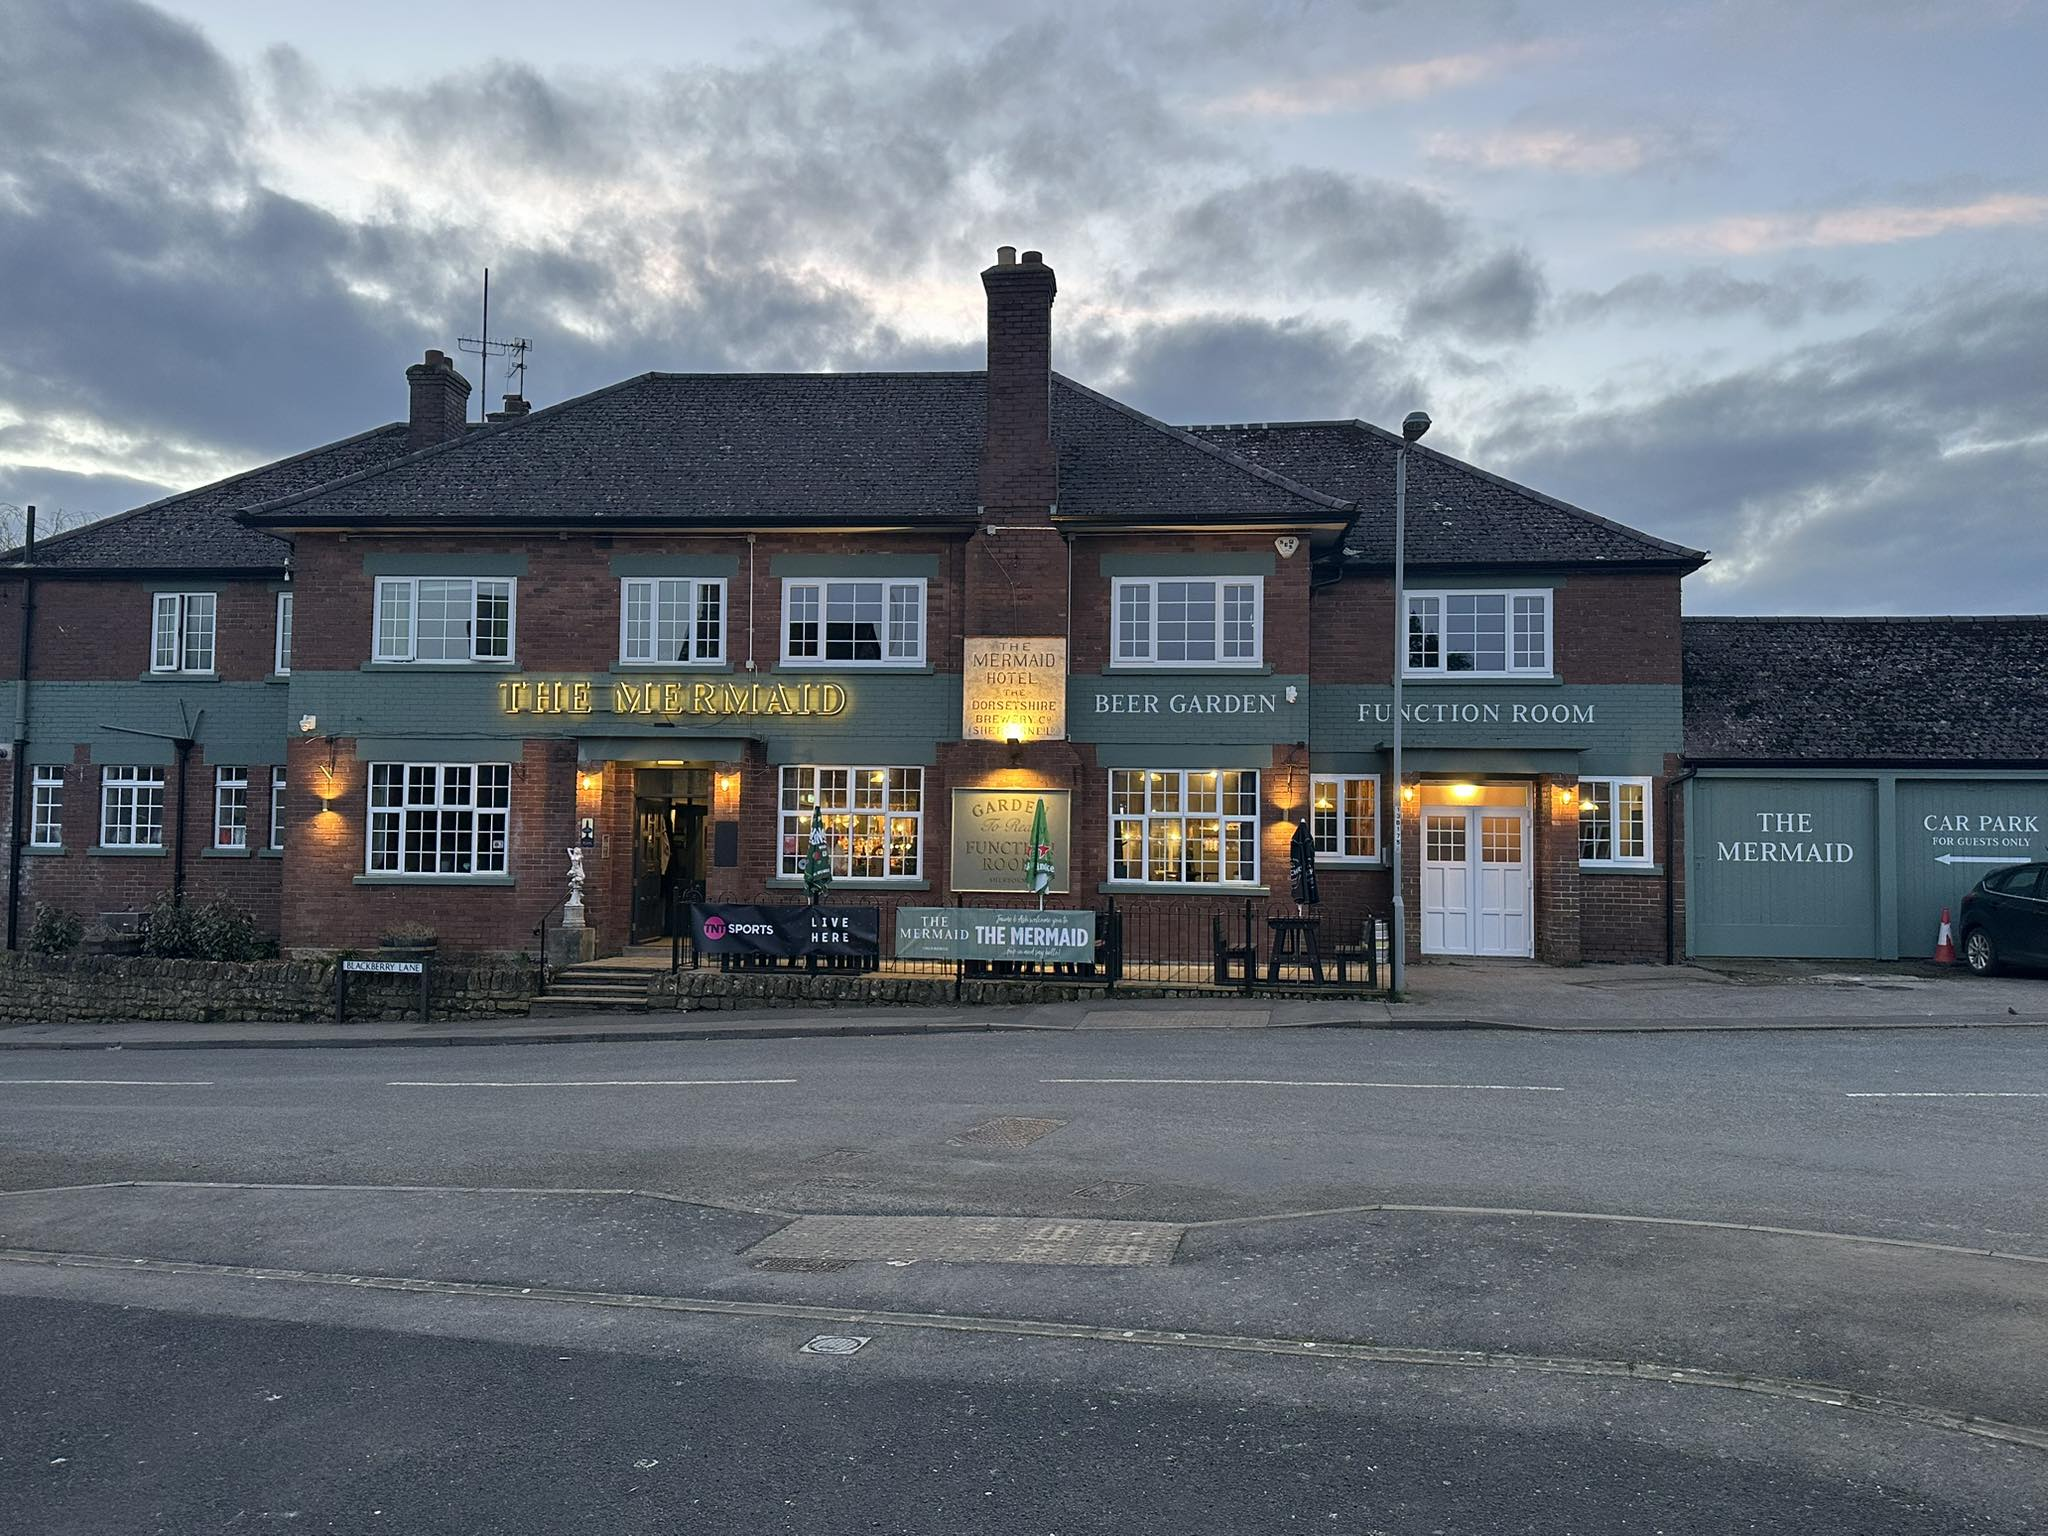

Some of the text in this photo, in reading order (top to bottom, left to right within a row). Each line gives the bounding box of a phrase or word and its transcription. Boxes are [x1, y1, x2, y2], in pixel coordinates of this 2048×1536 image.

[1000, 642, 1031, 651] THE
[973, 653, 1055, 668] MERMAID
[499, 681, 847, 715] THE MERMAID
[1004, 689, 1026, 697] THE
[972, 701, 1057, 711] DORSETSHIRE
[1095, 694, 1276, 713] BEER GARDEN
[1358, 703, 1595, 723] FUNCTION ROOM
[972, 799, 1049, 817] GARDE
[981, 818, 1032, 833] To Rea
[1756, 813, 1813, 833] THE
[1924, 815, 2039, 832] CAR PARK
[966, 841, 1055, 855] FUNCTI
[1932, 837, 2031, 847] FOR GUESTS ONLY
[1717, 841, 1854, 863] MERMAID
[983, 858, 1028, 872] ROO
[811, 917, 849, 928] LIVE
[921, 916, 949, 927] THE
[705, 923, 774, 935] TNT SPORTS
[900, 928, 969, 940] MERMAID
[811, 932, 849, 943] HERE
[975, 926, 1089, 947] THE MERMAID
[346, 962, 420, 972] BLACKBERRY LANE
